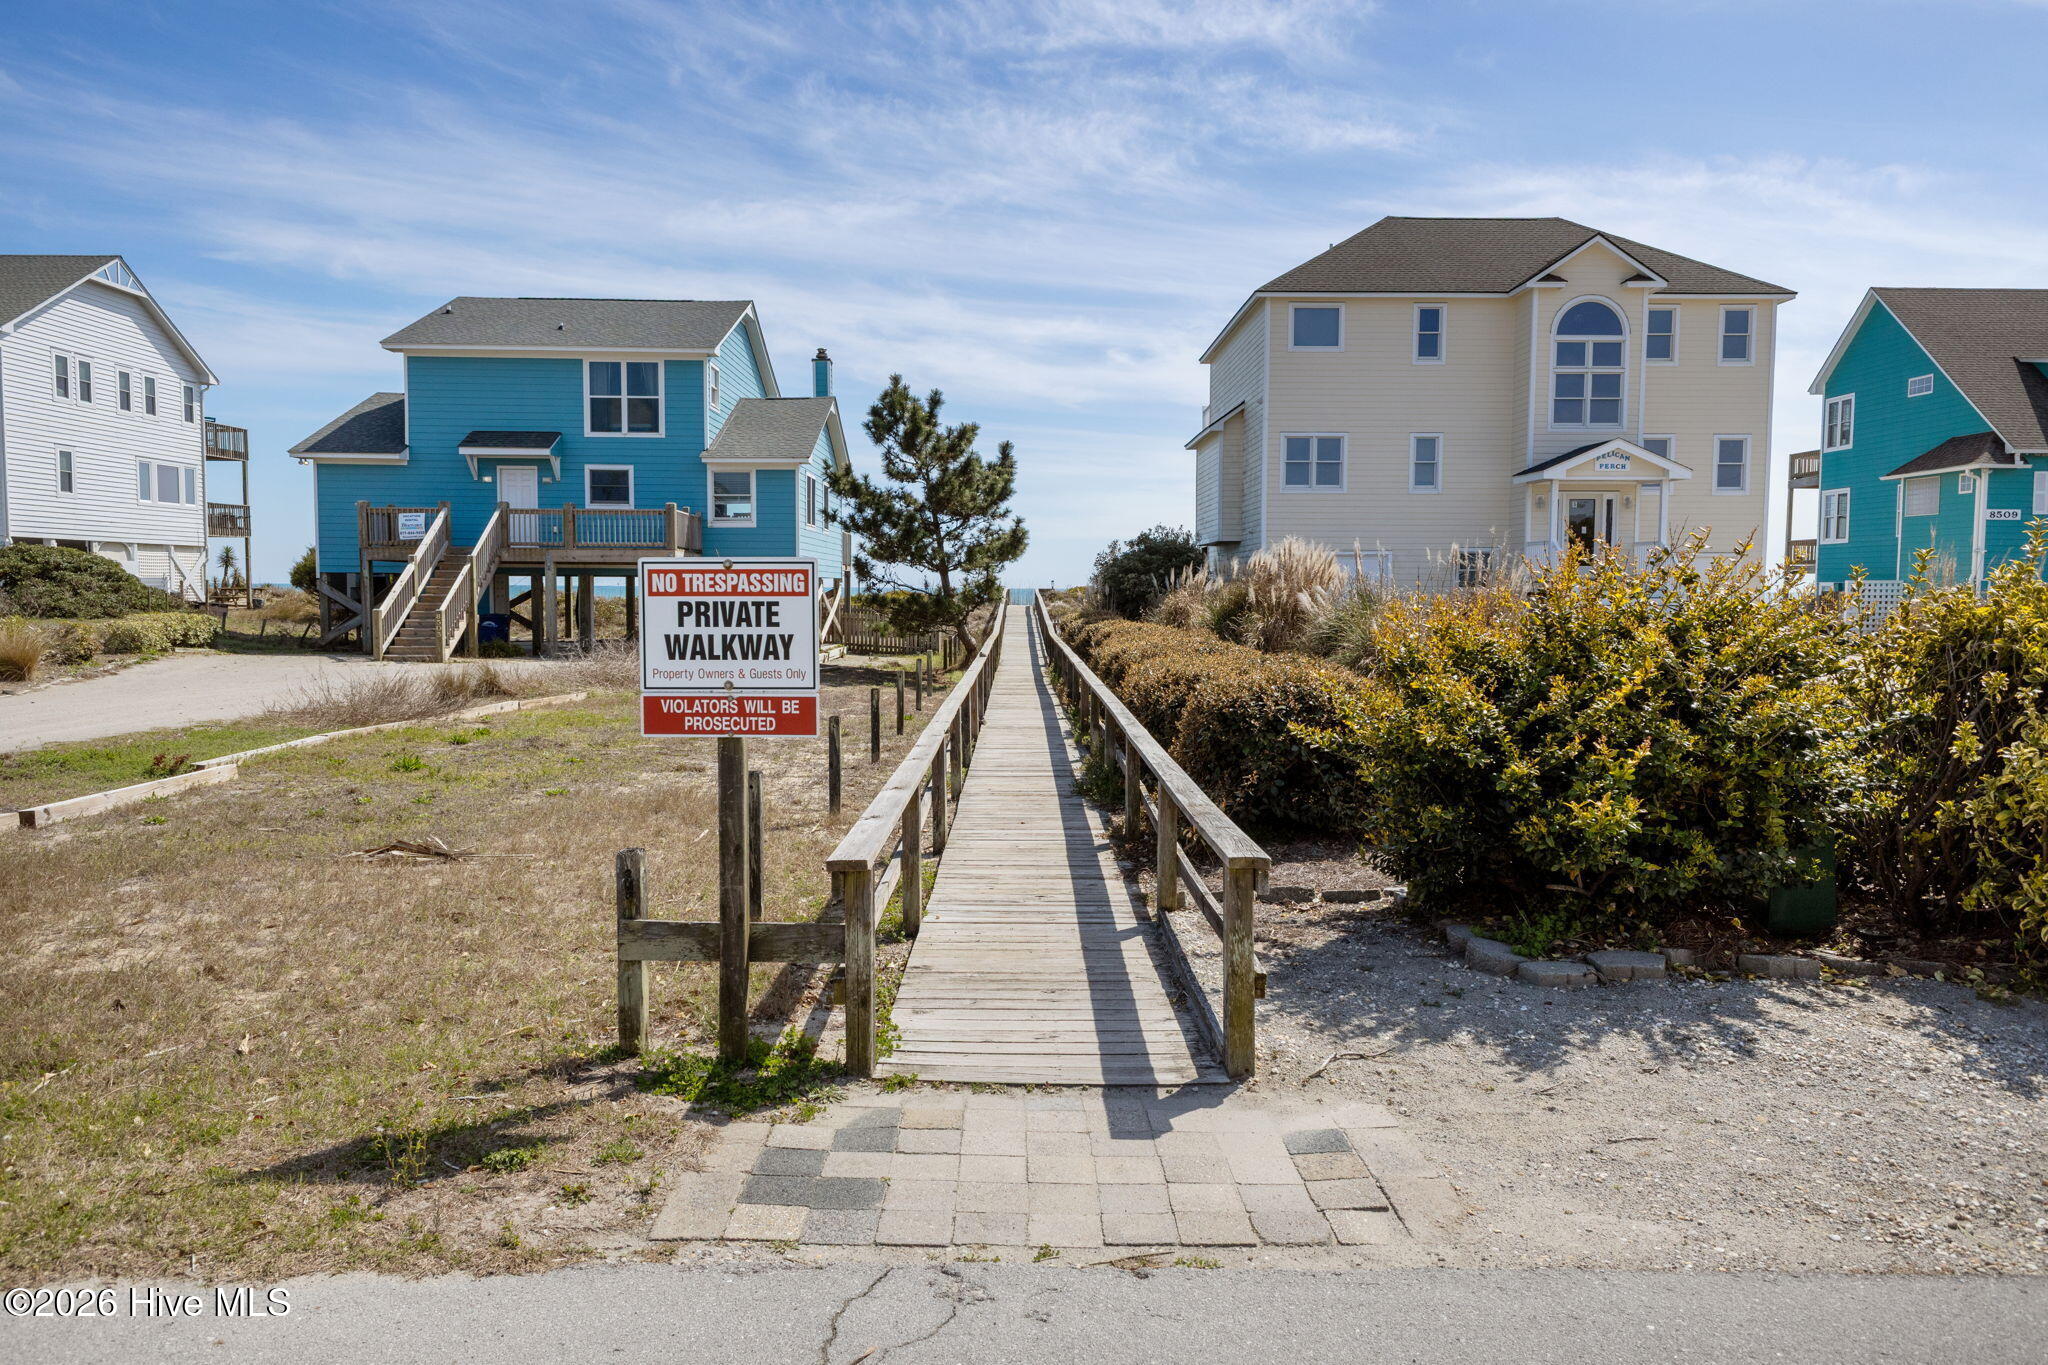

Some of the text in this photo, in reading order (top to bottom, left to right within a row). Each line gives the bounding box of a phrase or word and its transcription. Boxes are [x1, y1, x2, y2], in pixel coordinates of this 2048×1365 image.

[1596, 451, 1631, 462] PELICAN
[1989, 511, 2018, 519] 8509
[651, 573, 805, 593] NO TRESPASSING
[677, 601, 780, 628] PRIVATE
[664, 633, 795, 661] WALKWAY
[652, 668, 807, 681] Property Owners & Guests Only
[660, 699, 800, 714] VIOLATORS WILL BE
[684, 717, 776, 731] PROSECUTED
